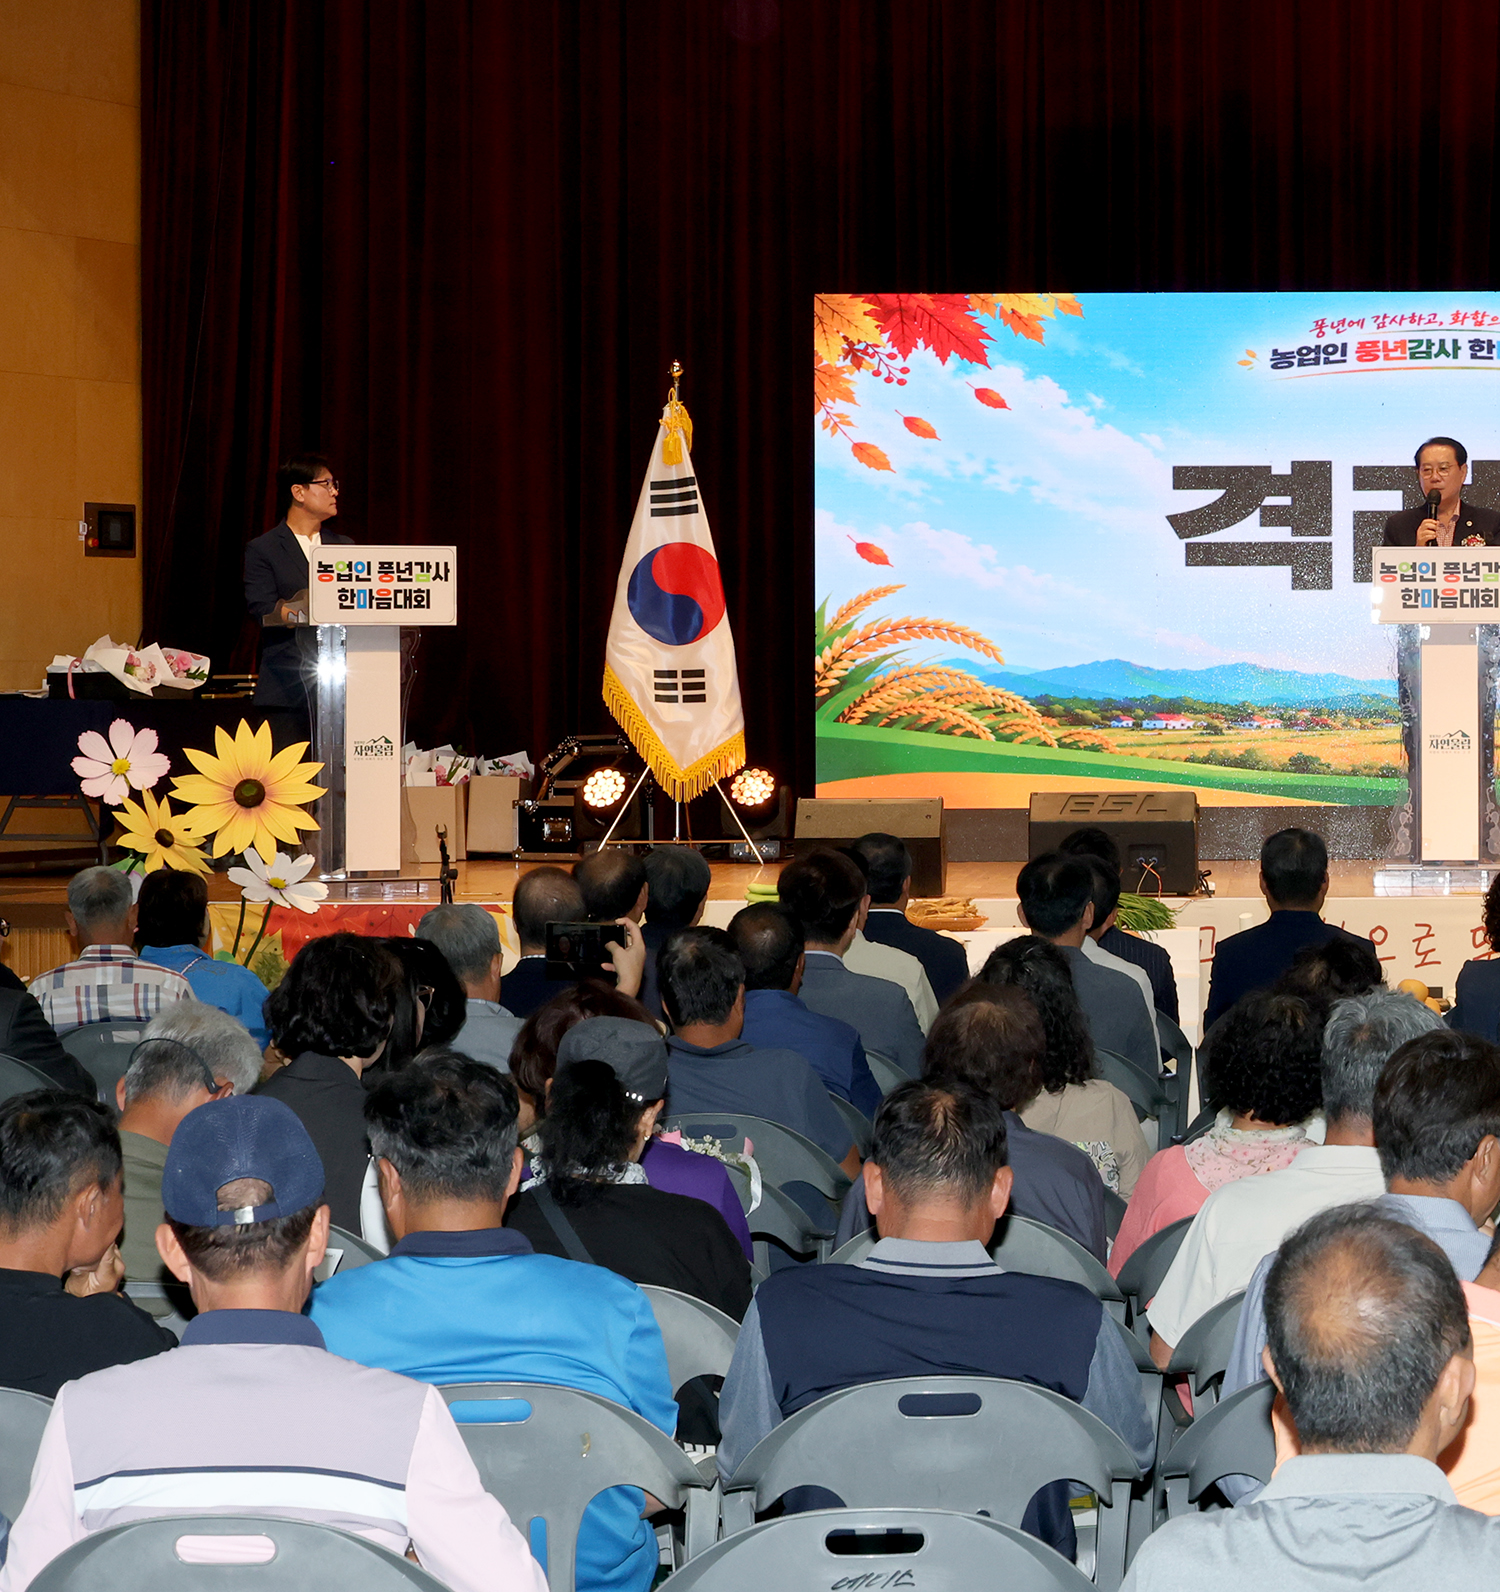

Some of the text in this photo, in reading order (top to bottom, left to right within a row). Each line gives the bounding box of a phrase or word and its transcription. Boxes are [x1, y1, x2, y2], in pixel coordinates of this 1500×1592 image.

[1309, 317, 1366, 338] 풍년에
[1371, 312, 1444, 329] 감사하고,
[1269, 341, 1349, 371] 농업인
[1355, 338, 1462, 363] 풍년감사
[317, 561, 450, 583] 농업인 풍년감사
[1379, 561, 1437, 583] 농업인
[337, 588, 431, 610] 한마음대회
[1401, 587, 1499, 609] 한마음대회
